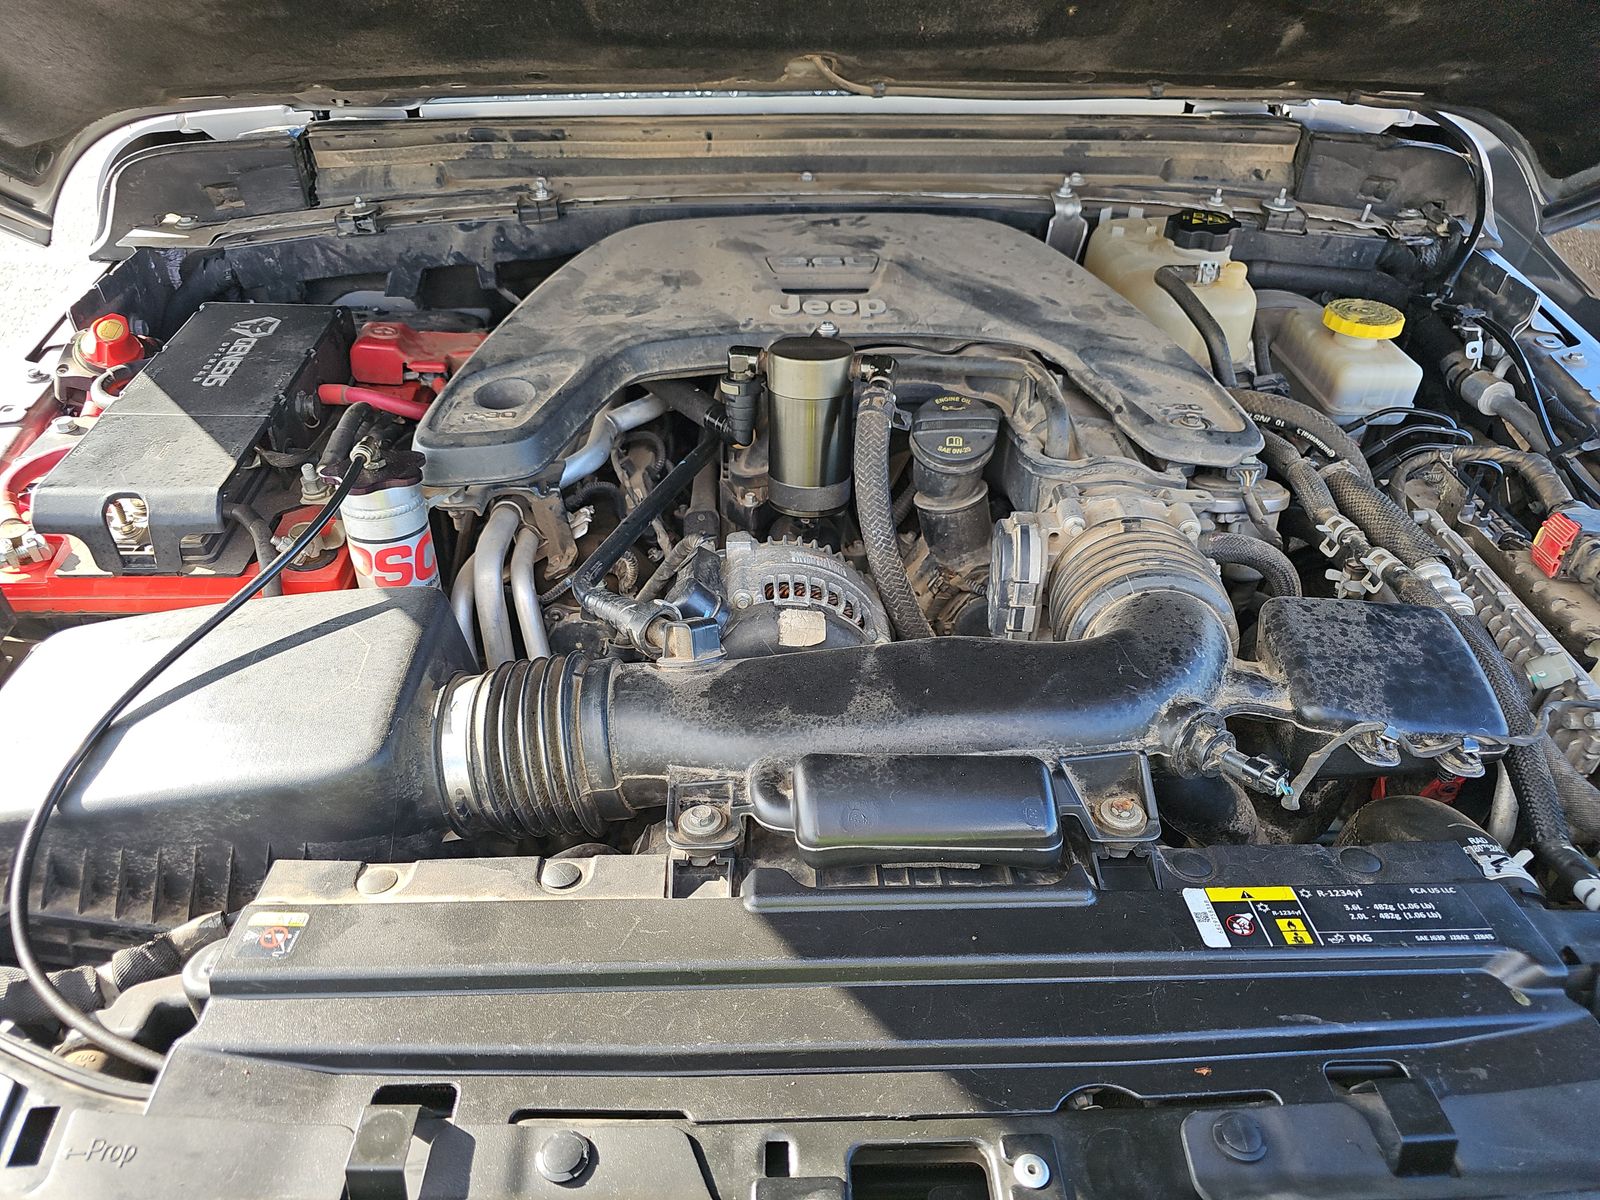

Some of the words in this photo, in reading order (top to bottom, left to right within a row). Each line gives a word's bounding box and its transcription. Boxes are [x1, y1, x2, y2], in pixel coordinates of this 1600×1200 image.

[769, 294, 888, 319] Jeep
[201, 337, 258, 387] GENESIS
[934, 396, 960, 405] ENGINE
[961, 397, 972, 405] OIL
[937, 445, 951, 454] SAE
[1467, 836, 1489, 845] RAD
[1316, 888, 1363, 898] R-1234yf
[1343, 903, 1363, 911] 3.6L
[1373, 903, 1396, 911] 482g
[1397, 902, 1420, 911] (1.06
[1379, 912, 1402, 920] 482g
[1403, 911, 1426, 920] (1.06
[1348, 933, 1373, 943] PAG
[86, 1139, 138, 1168] Prop
